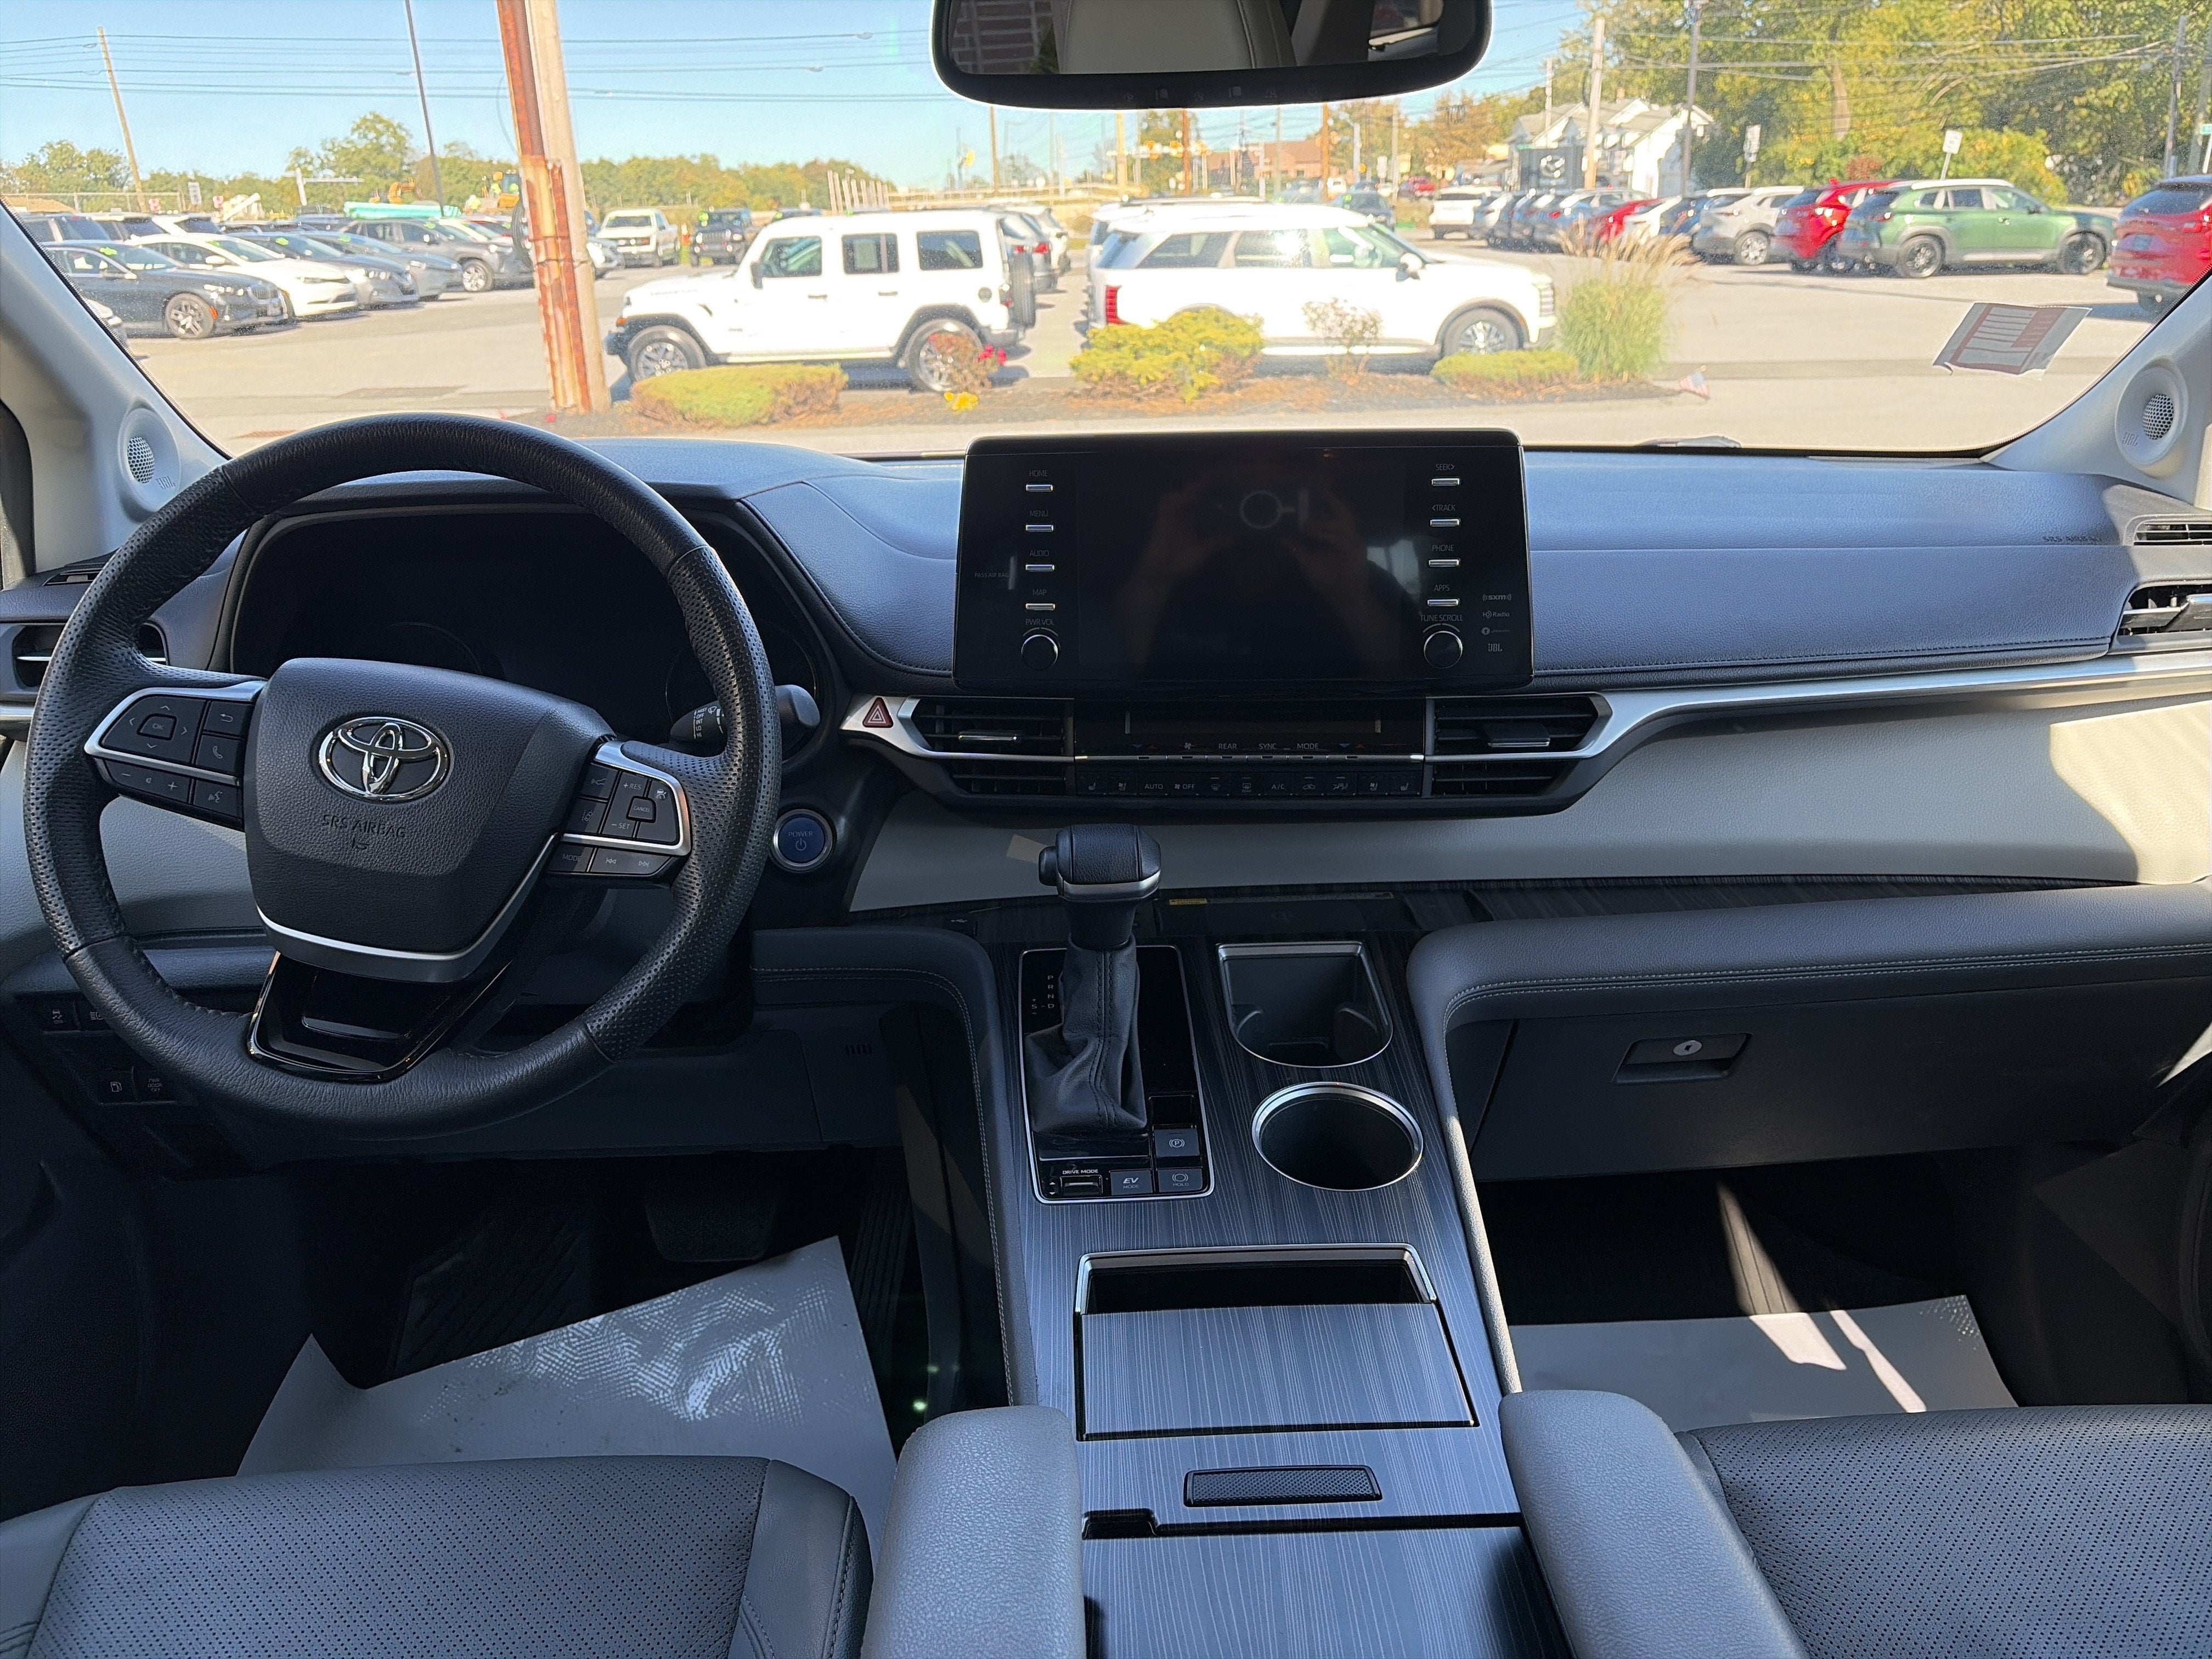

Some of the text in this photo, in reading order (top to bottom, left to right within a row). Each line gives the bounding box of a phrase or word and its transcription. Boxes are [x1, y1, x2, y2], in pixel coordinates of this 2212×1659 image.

[1488, 643, 1503, 652] JBL
[322, 815, 405, 838] SRS AIRBAG
[562, 854, 582, 862] MODE
